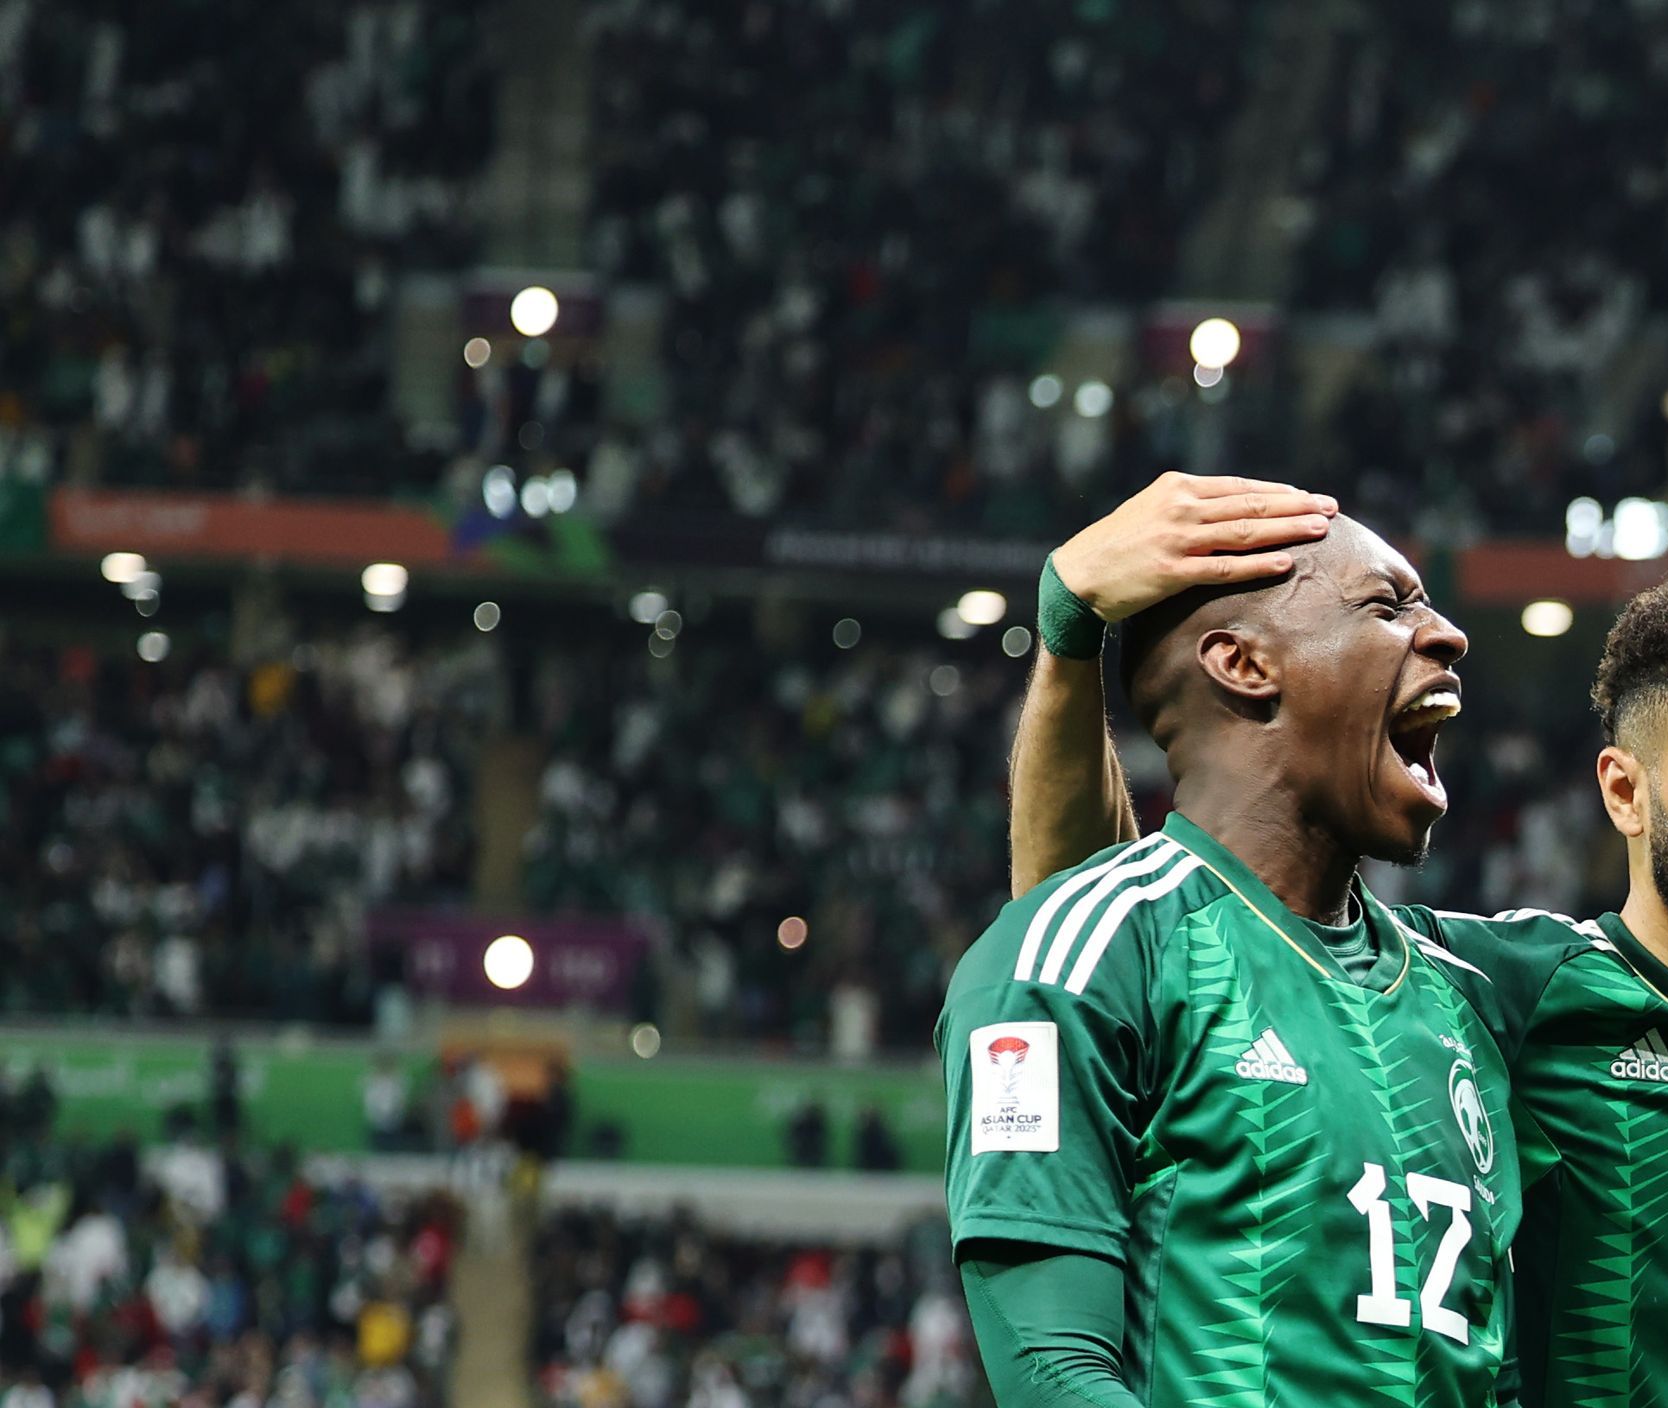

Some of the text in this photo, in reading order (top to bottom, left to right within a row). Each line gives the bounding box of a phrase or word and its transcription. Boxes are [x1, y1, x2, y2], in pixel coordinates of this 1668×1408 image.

[1235, 1060, 1308, 1086] adidas
[1000, 1106, 1017, 1114] AFC
[981, 1114, 1042, 1125] ASIAN CUP
[1347, 1162, 1472, 1346] 12
